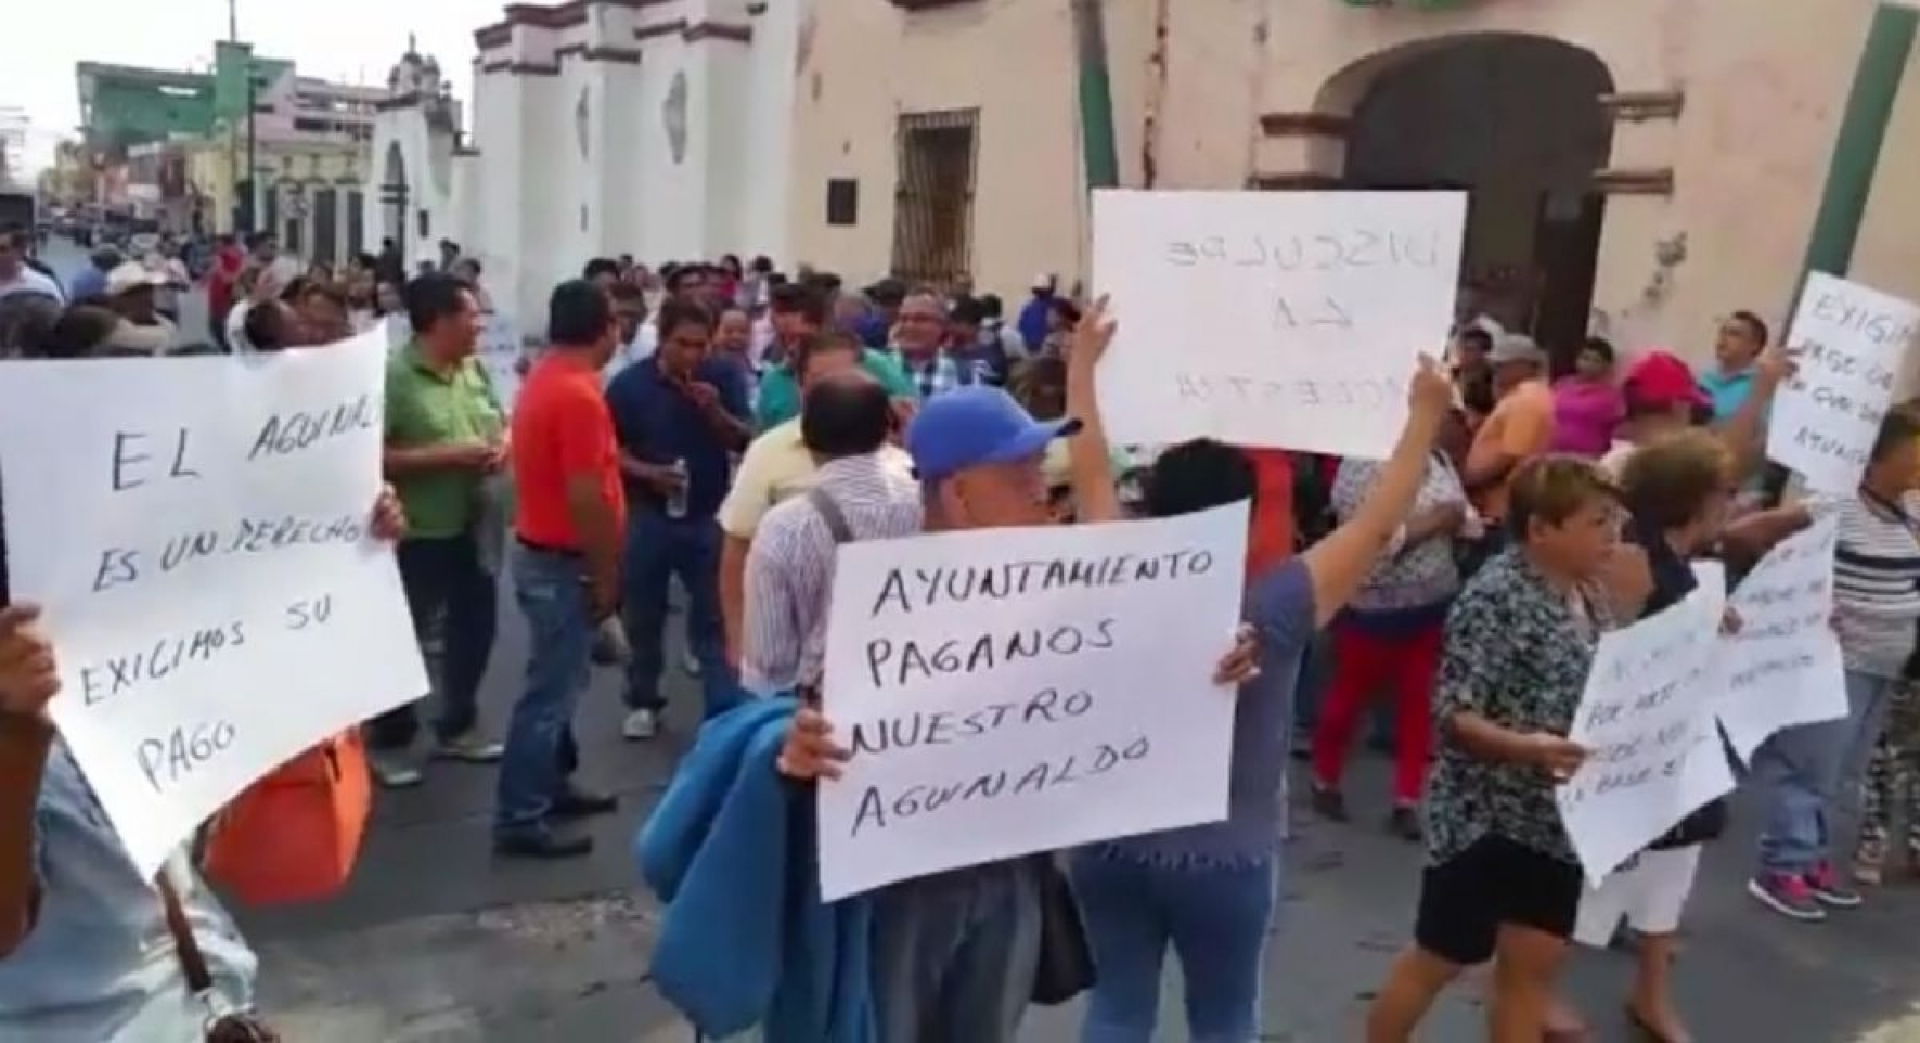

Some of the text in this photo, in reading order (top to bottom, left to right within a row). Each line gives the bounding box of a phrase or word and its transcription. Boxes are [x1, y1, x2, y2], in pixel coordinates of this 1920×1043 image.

[111, 427, 201, 491] EL
[92, 547, 141, 593] ES
[159, 528, 217, 572] UN
[871, 549, 1214, 617] AYUNTAMIENTO
[286, 595, 332, 631] SU
[865, 618, 1118, 688] PAGANOS
[850, 688, 1094, 755] NUESTRO
[137, 722, 236, 790] PAGO
